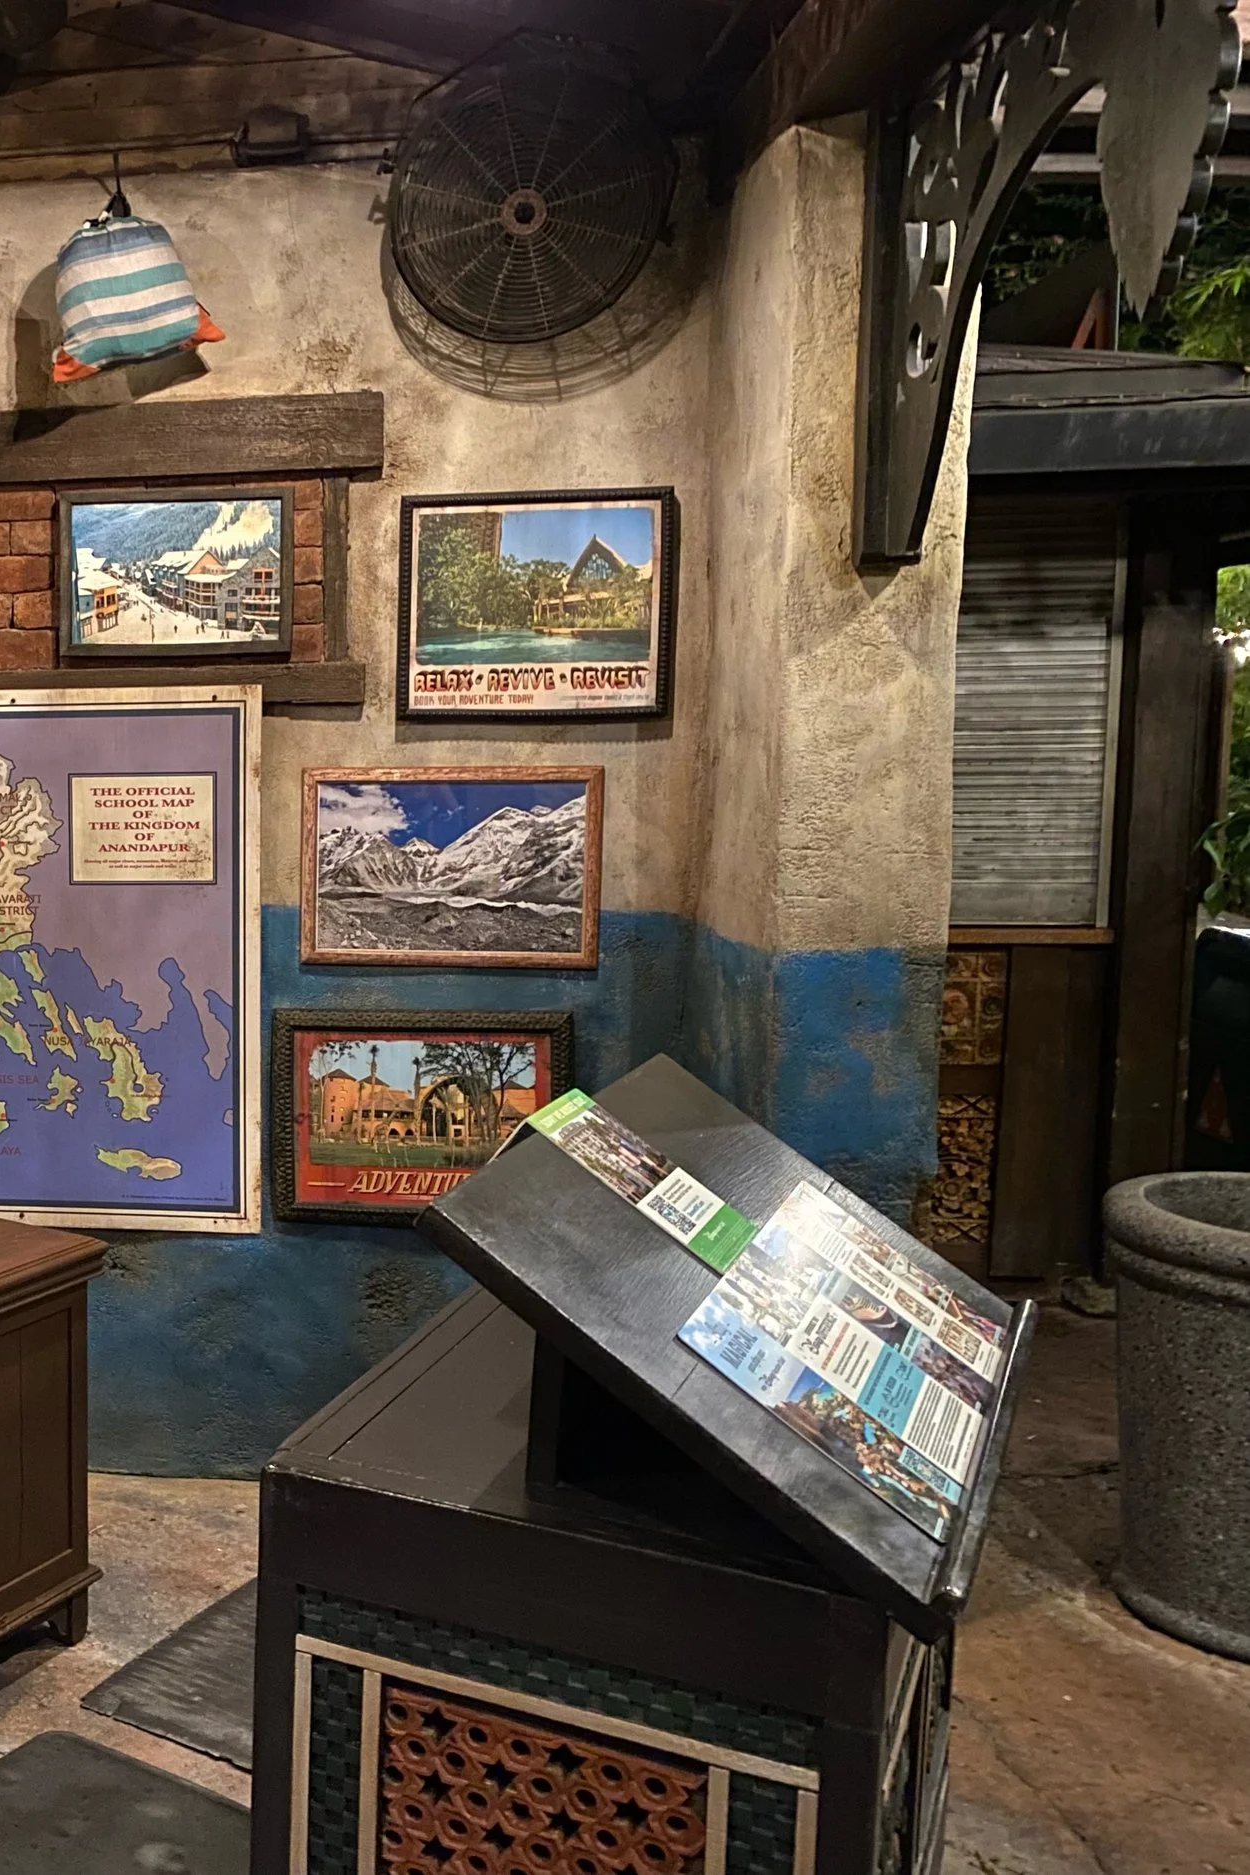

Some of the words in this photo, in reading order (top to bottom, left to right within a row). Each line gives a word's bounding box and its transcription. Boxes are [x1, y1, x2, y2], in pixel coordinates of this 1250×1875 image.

[413, 669, 474, 692] RELAX
[487, 667, 556, 691] REVIVE
[570, 666, 650, 690] REVISIT
[413, 695, 435, 706] BOOK
[438, 695, 456, 706] YOUR
[459, 694, 504, 705] ADVENTURE
[507, 694, 534, 705] TODAY!
[90, 787, 122, 796] THE
[125, 787, 196, 796] OFFICIAL
[94, 799, 159, 808] SCHOOL
[161, 798, 195, 808] MAP
[132, 810, 154, 819] OF
[88, 821, 121, 830] THE
[124, 821, 201, 830] KINGDOM
[134, 832, 155, 841] OF
[98, 843, 191, 853] ANANDAPUR
[17, 1075, 40, 1085] SEA
[348, 1170, 471, 1195] ADVENTU
